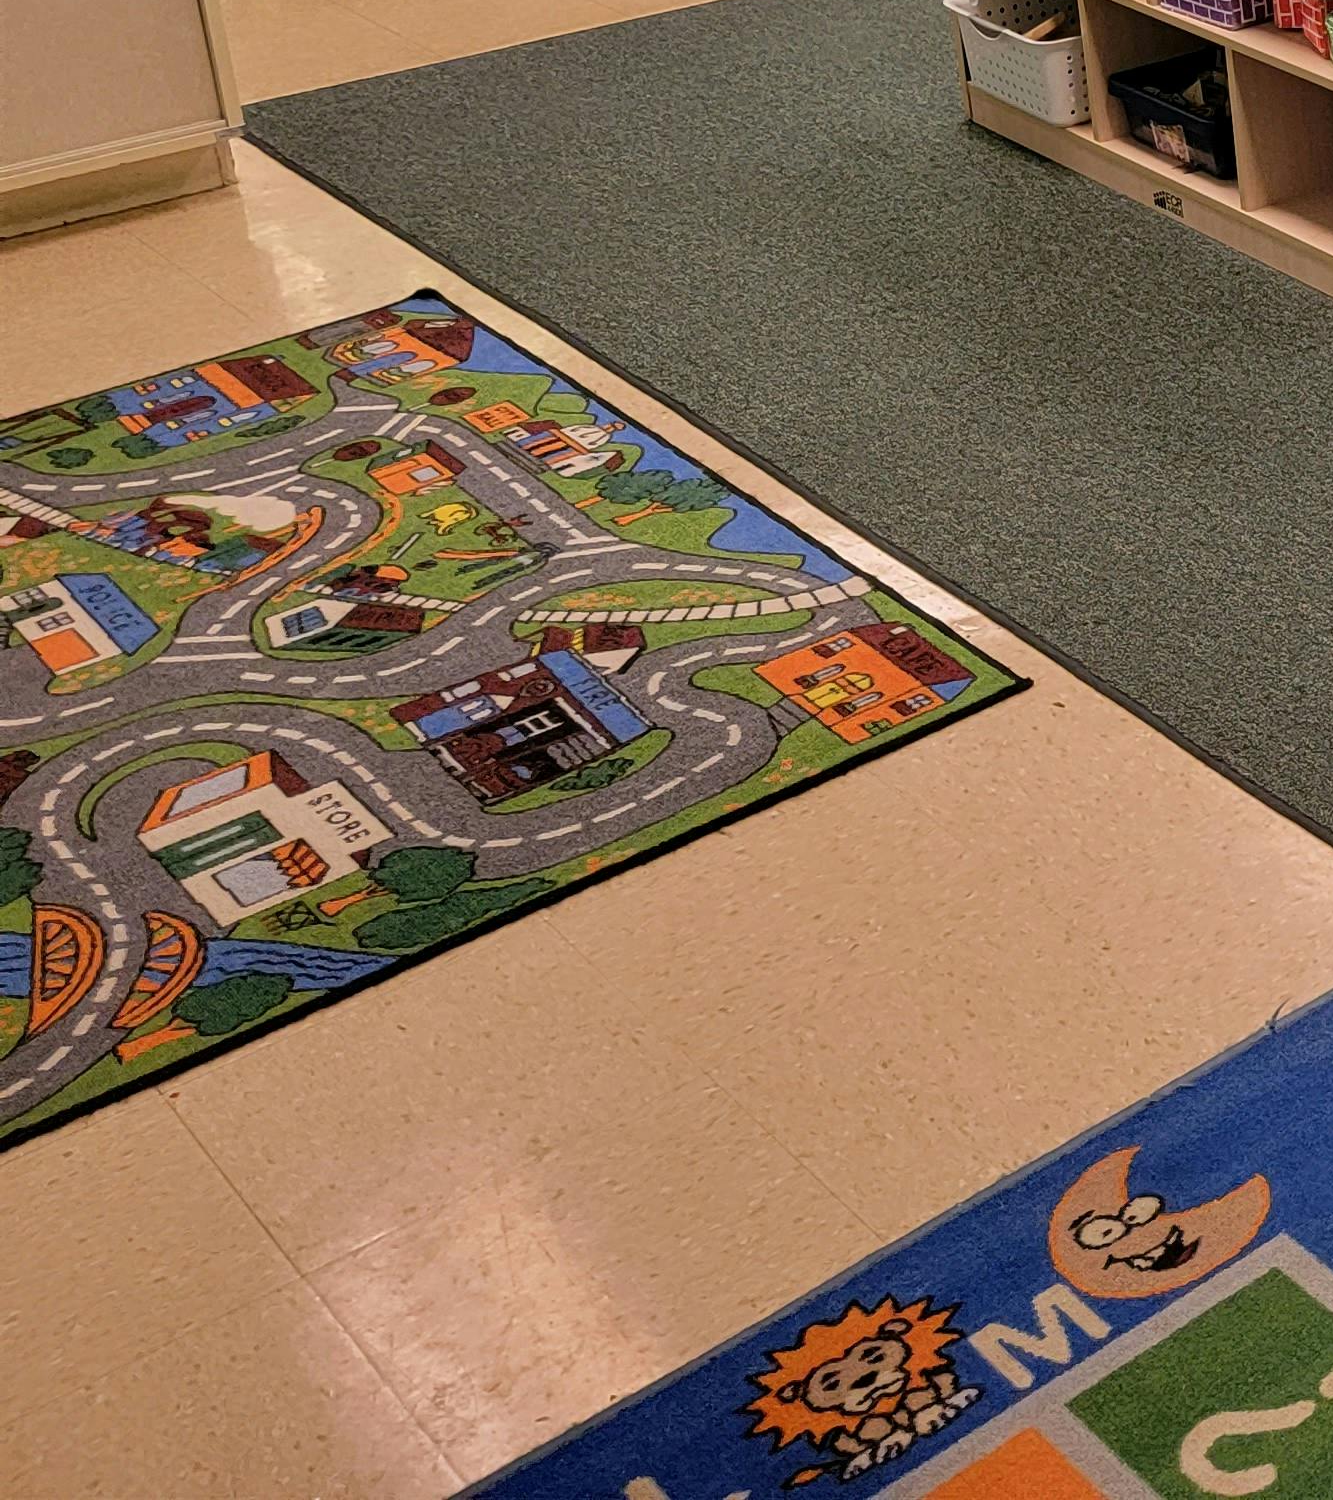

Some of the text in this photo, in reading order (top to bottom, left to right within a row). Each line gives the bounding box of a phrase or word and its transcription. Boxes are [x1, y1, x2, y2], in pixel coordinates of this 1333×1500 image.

[78, 584, 143, 632] POLICE
[306, 793, 371, 844] STORE
[966, 1282, 1114, 1389] M
